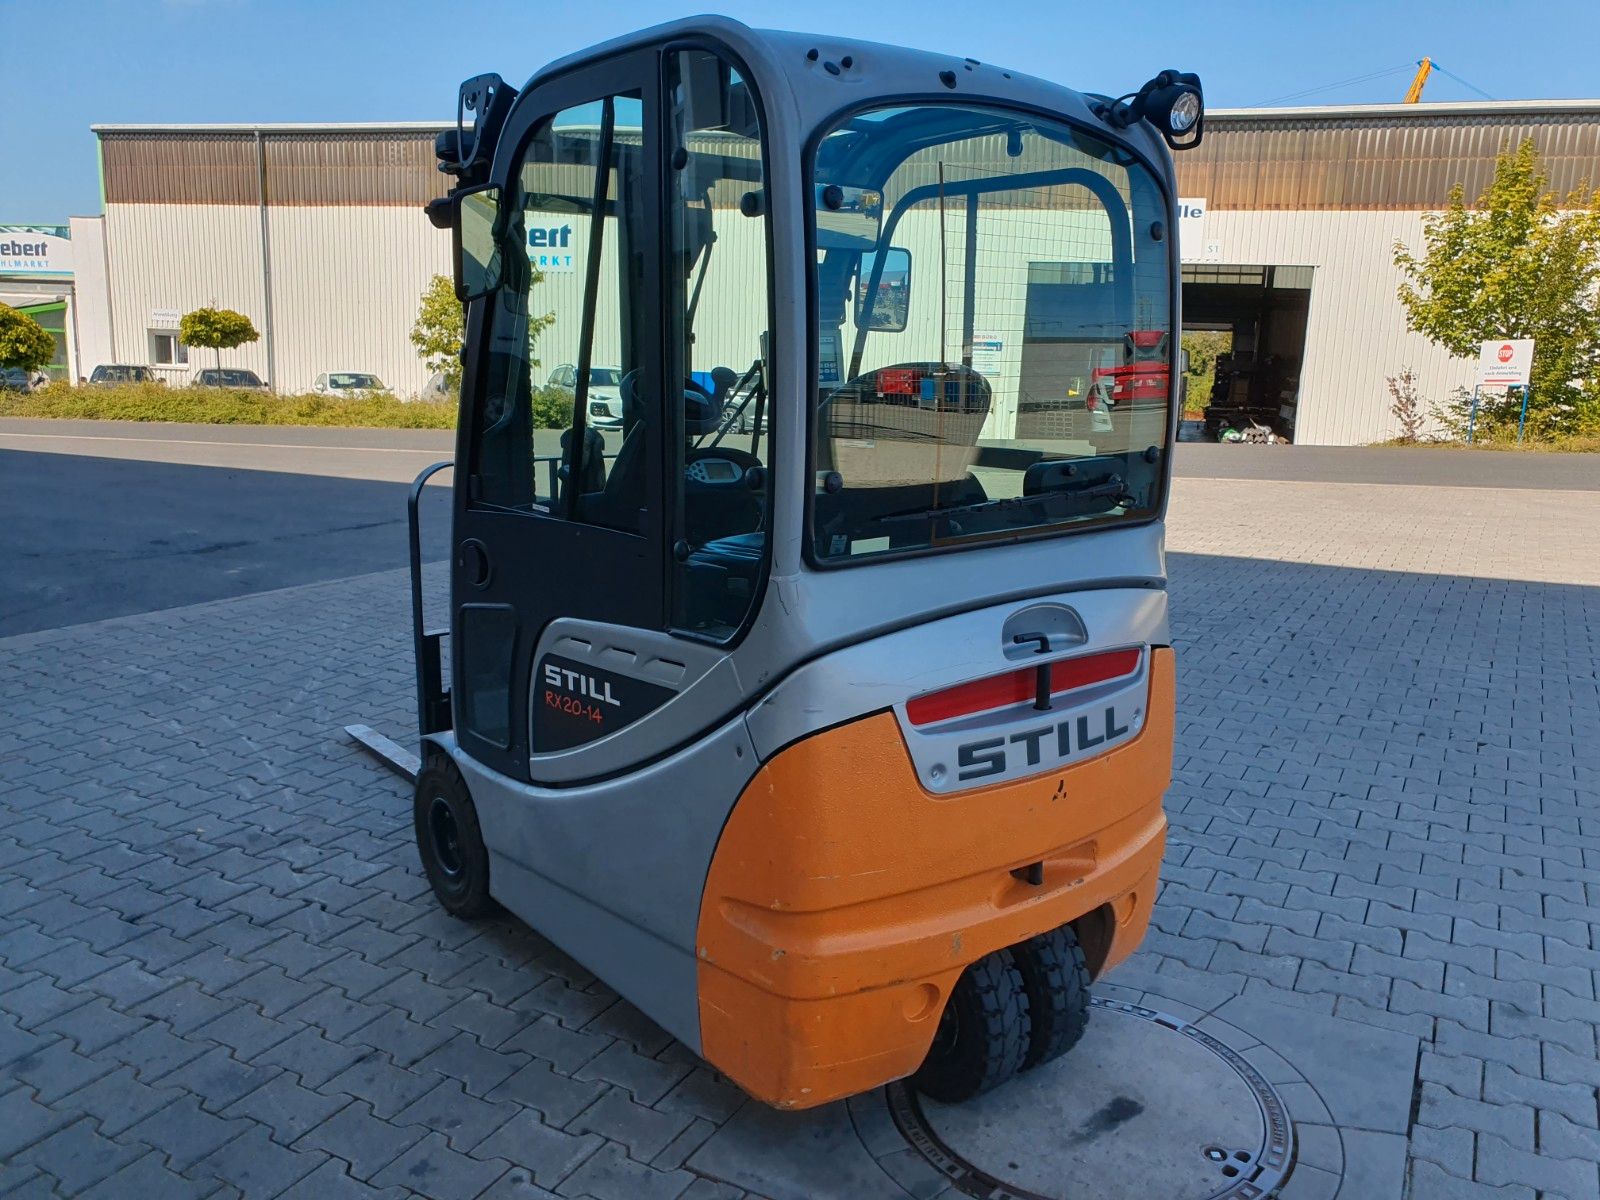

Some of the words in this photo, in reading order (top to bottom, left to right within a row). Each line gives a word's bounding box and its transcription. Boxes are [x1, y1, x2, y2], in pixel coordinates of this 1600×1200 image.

[0, 240, 48, 256] ebert
[1498, 349, 1514, 358] STOP
[544, 664, 621, 707] STILL
[957, 706, 1129, 782] STILL
